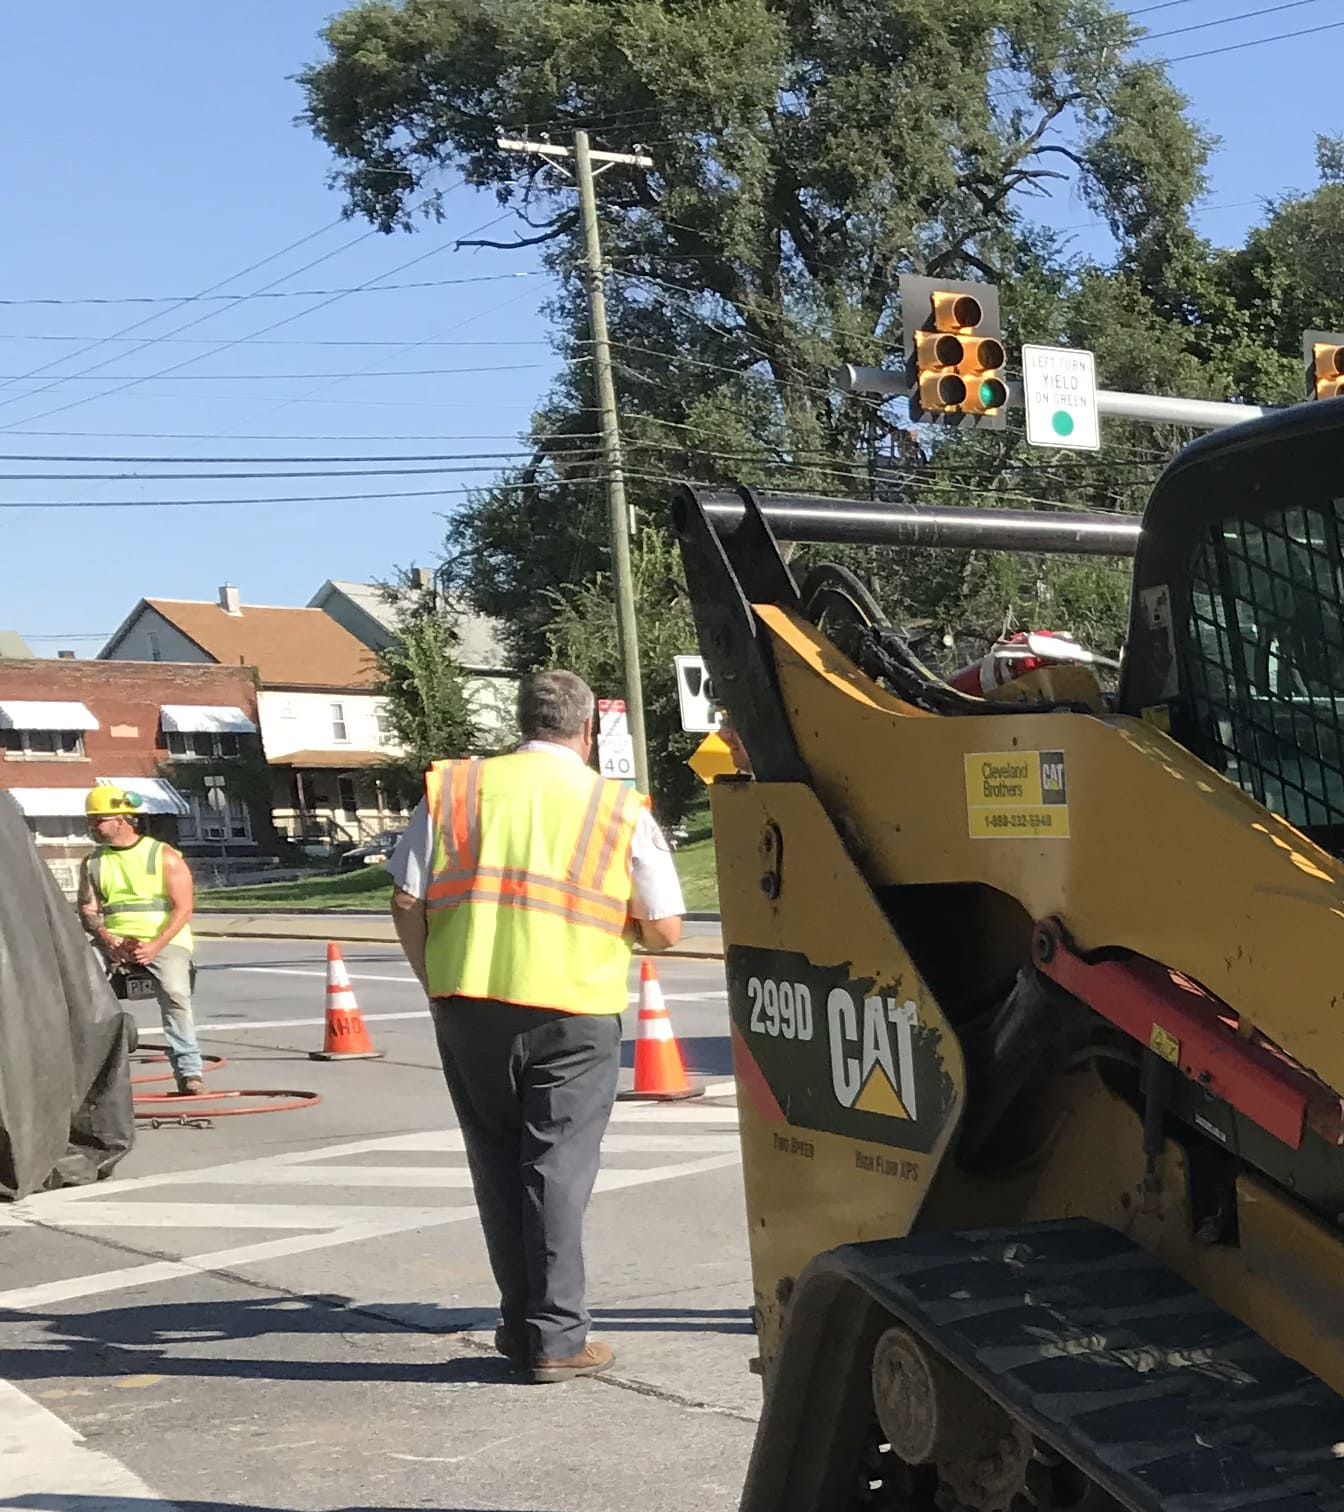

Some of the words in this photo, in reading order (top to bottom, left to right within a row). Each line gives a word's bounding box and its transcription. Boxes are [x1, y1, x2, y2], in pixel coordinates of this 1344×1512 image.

[1031, 355, 1055, 369] LEFT
[1059, 357, 1086, 372] TURN
[1042, 373, 1078, 390] YIELD
[1035, 391, 1049, 404] ON
[1053, 393, 1087, 408] GREEN
[604, 757, 630, 774] 40
[982, 761, 1028, 780] Cleveland
[1042, 763, 1064, 790] CAT
[983, 780, 1024, 798] Brothers
[747, 976, 814, 1041] 299D
[827, 987, 918, 1121] CAT
